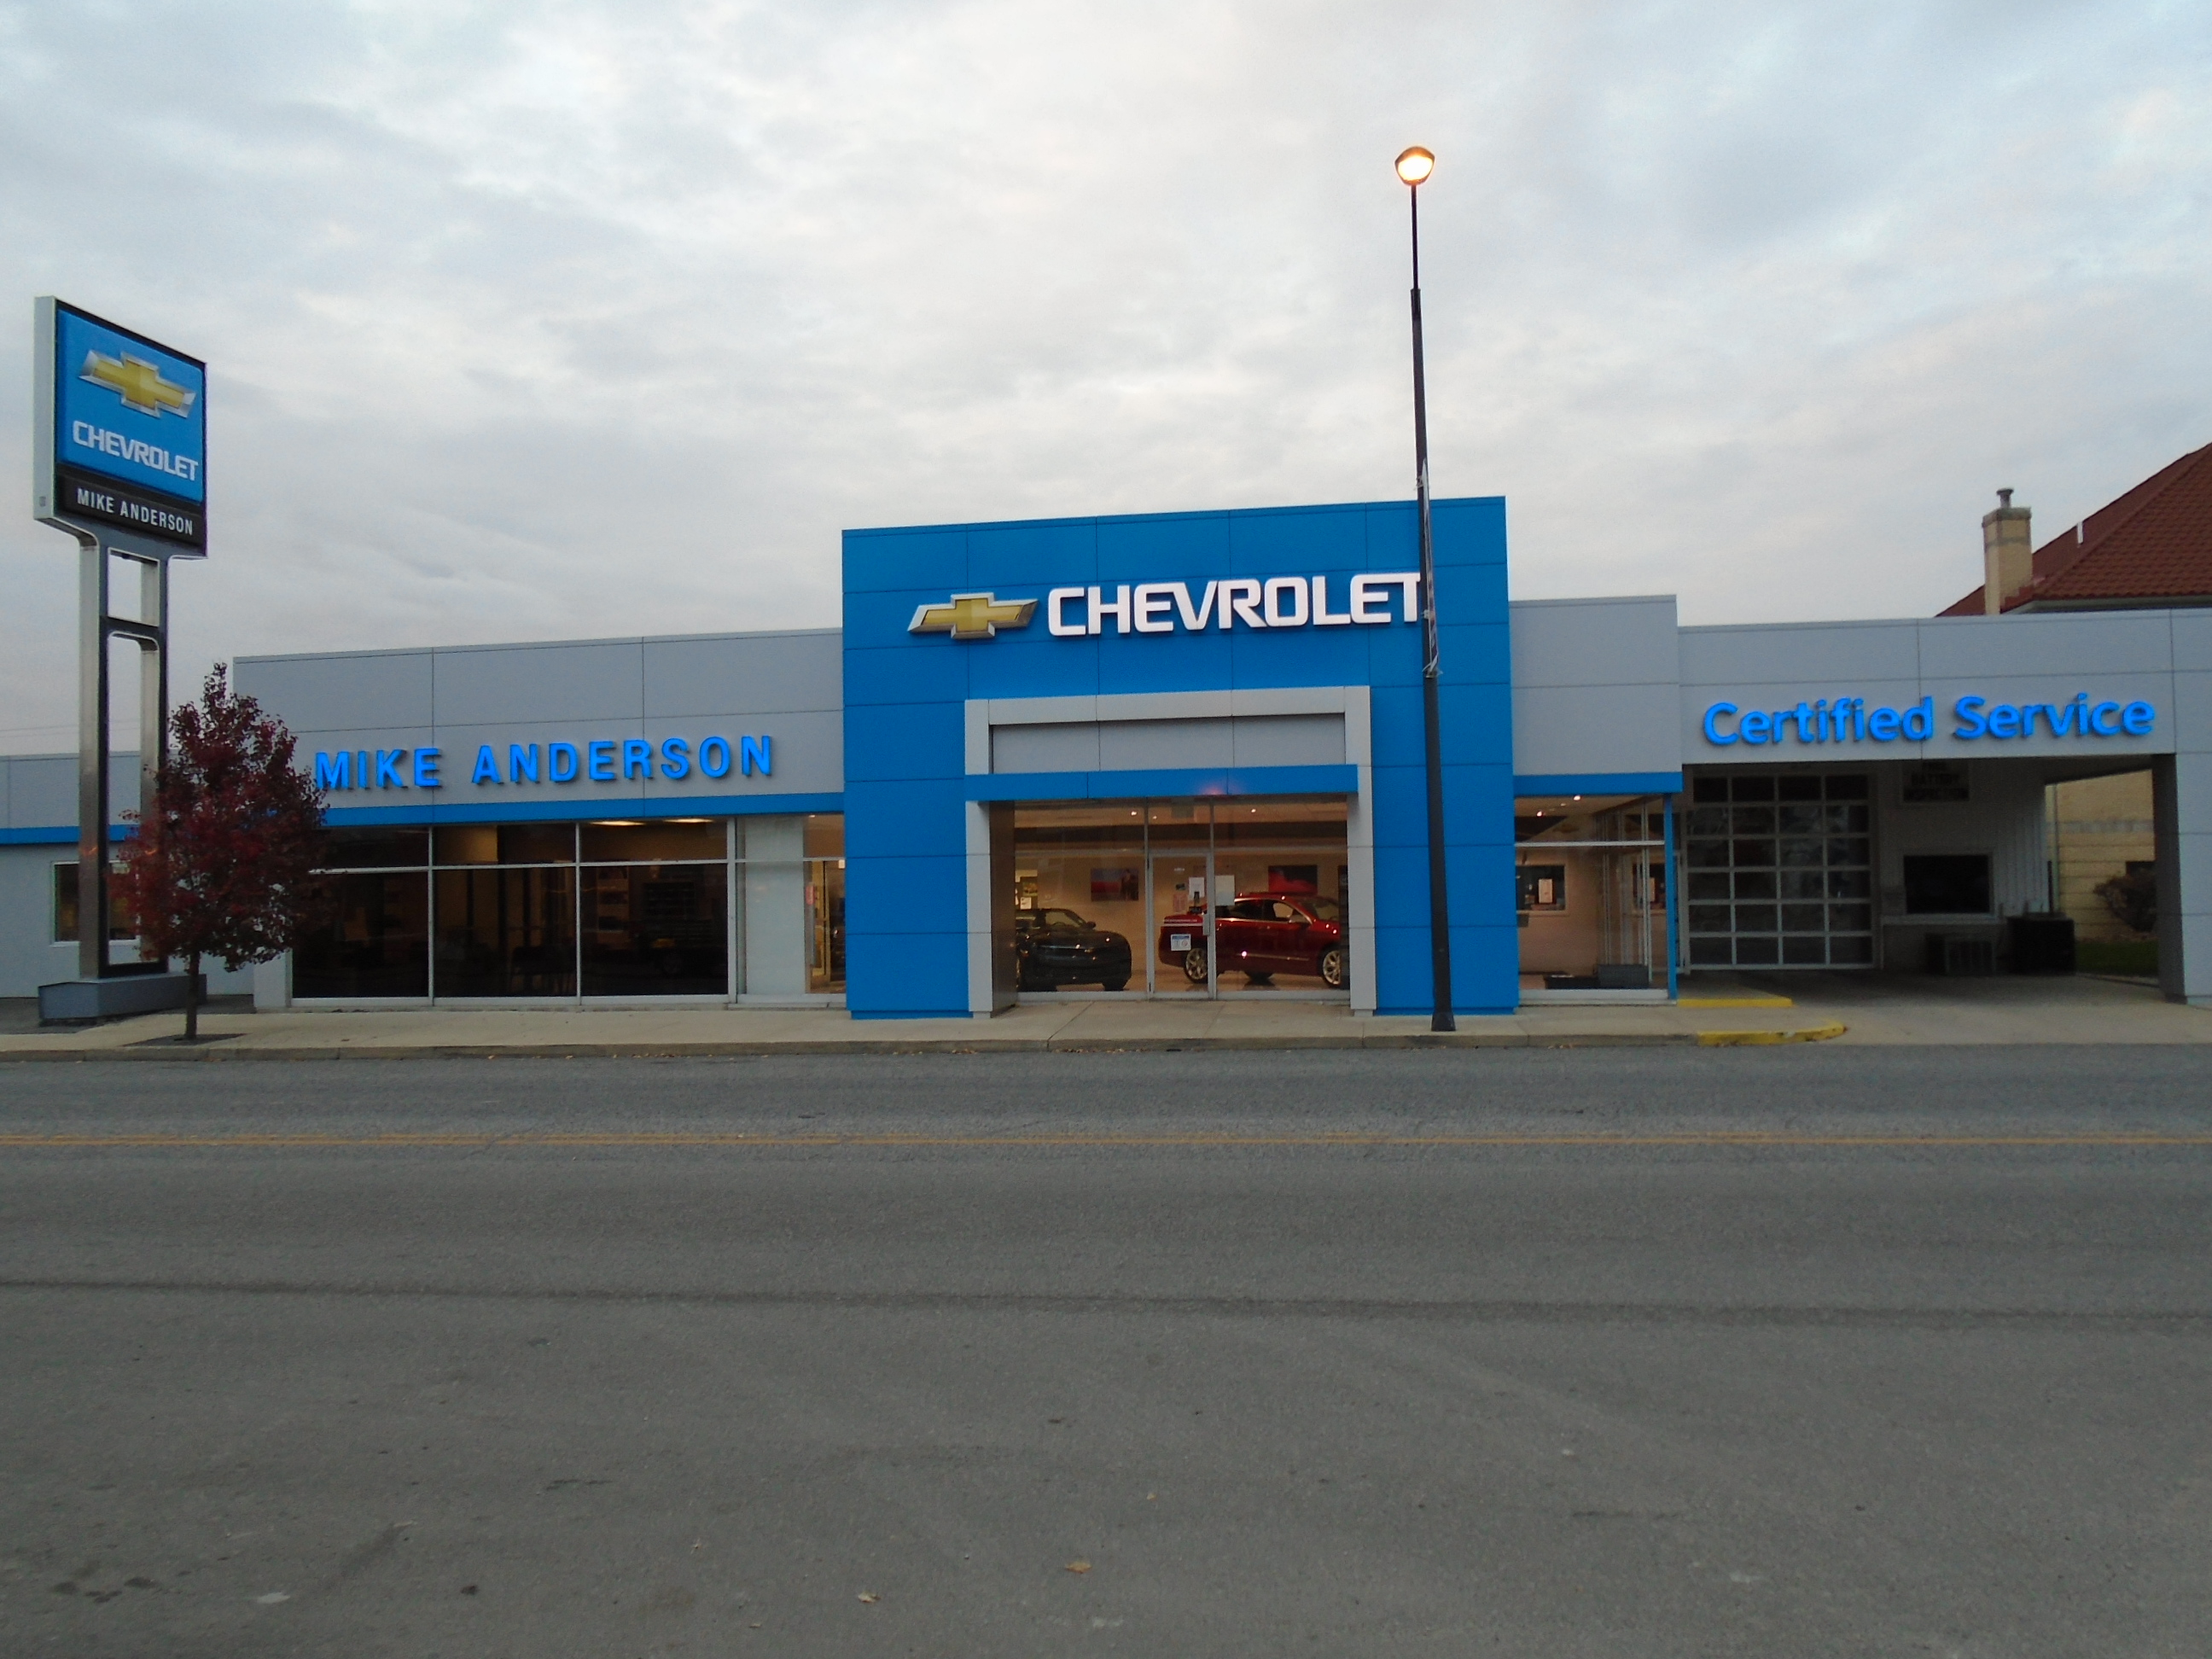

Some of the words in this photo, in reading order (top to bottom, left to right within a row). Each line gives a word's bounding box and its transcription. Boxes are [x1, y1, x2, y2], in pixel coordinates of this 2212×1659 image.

[73, 421, 198, 480] CHEVROLET
[77, 487, 114, 514] MIKE
[119, 500, 194, 536] ANDERSON
[1048, 573, 1421, 637] CHEVROLET
[1704, 696, 1933, 746] Certified
[1953, 692, 2156, 741] Service
[315, 748, 440, 789] MIKE
[471, 736, 773, 785] ANDERSON
